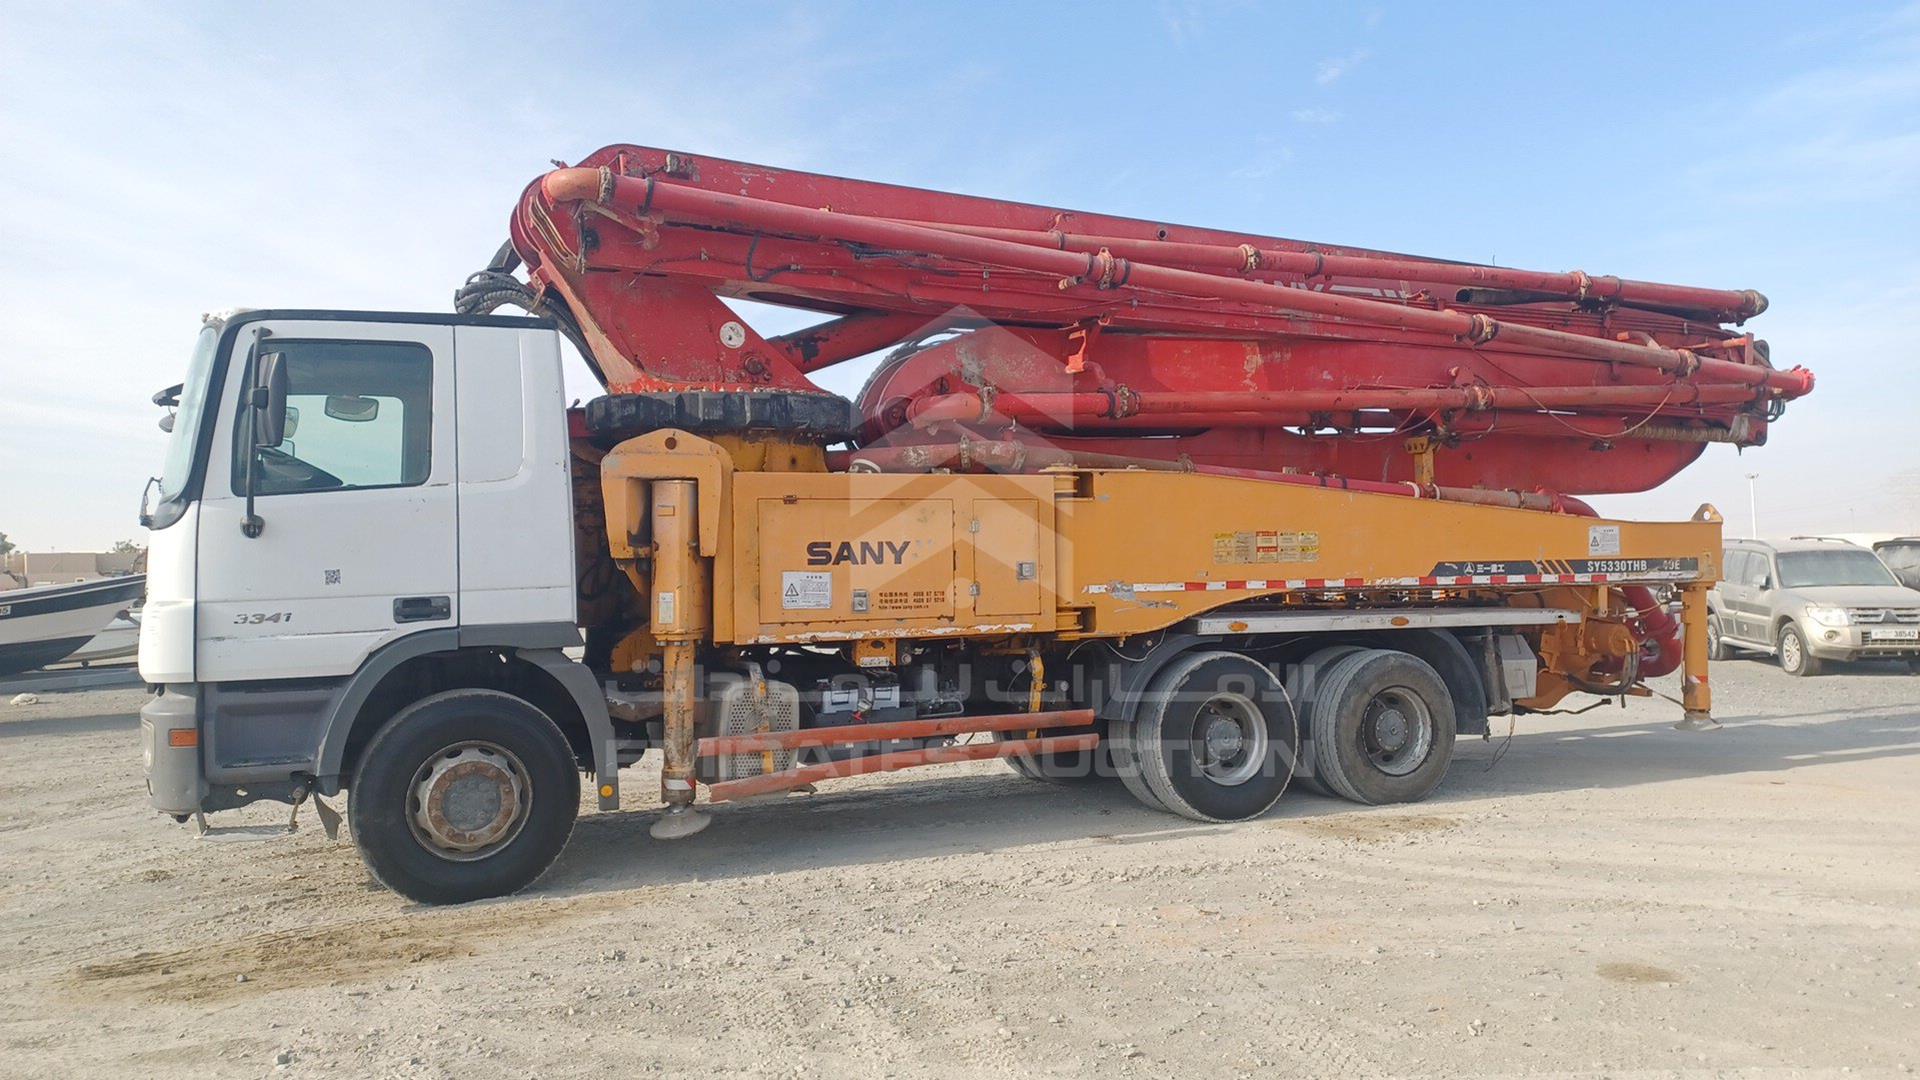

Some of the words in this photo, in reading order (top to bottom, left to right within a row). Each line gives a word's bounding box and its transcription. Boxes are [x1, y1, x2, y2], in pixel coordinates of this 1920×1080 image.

[806, 541, 911, 566] SANY
[1587, 560, 1648, 573] SY5330THB
[233, 612, 292, 624] 3341
